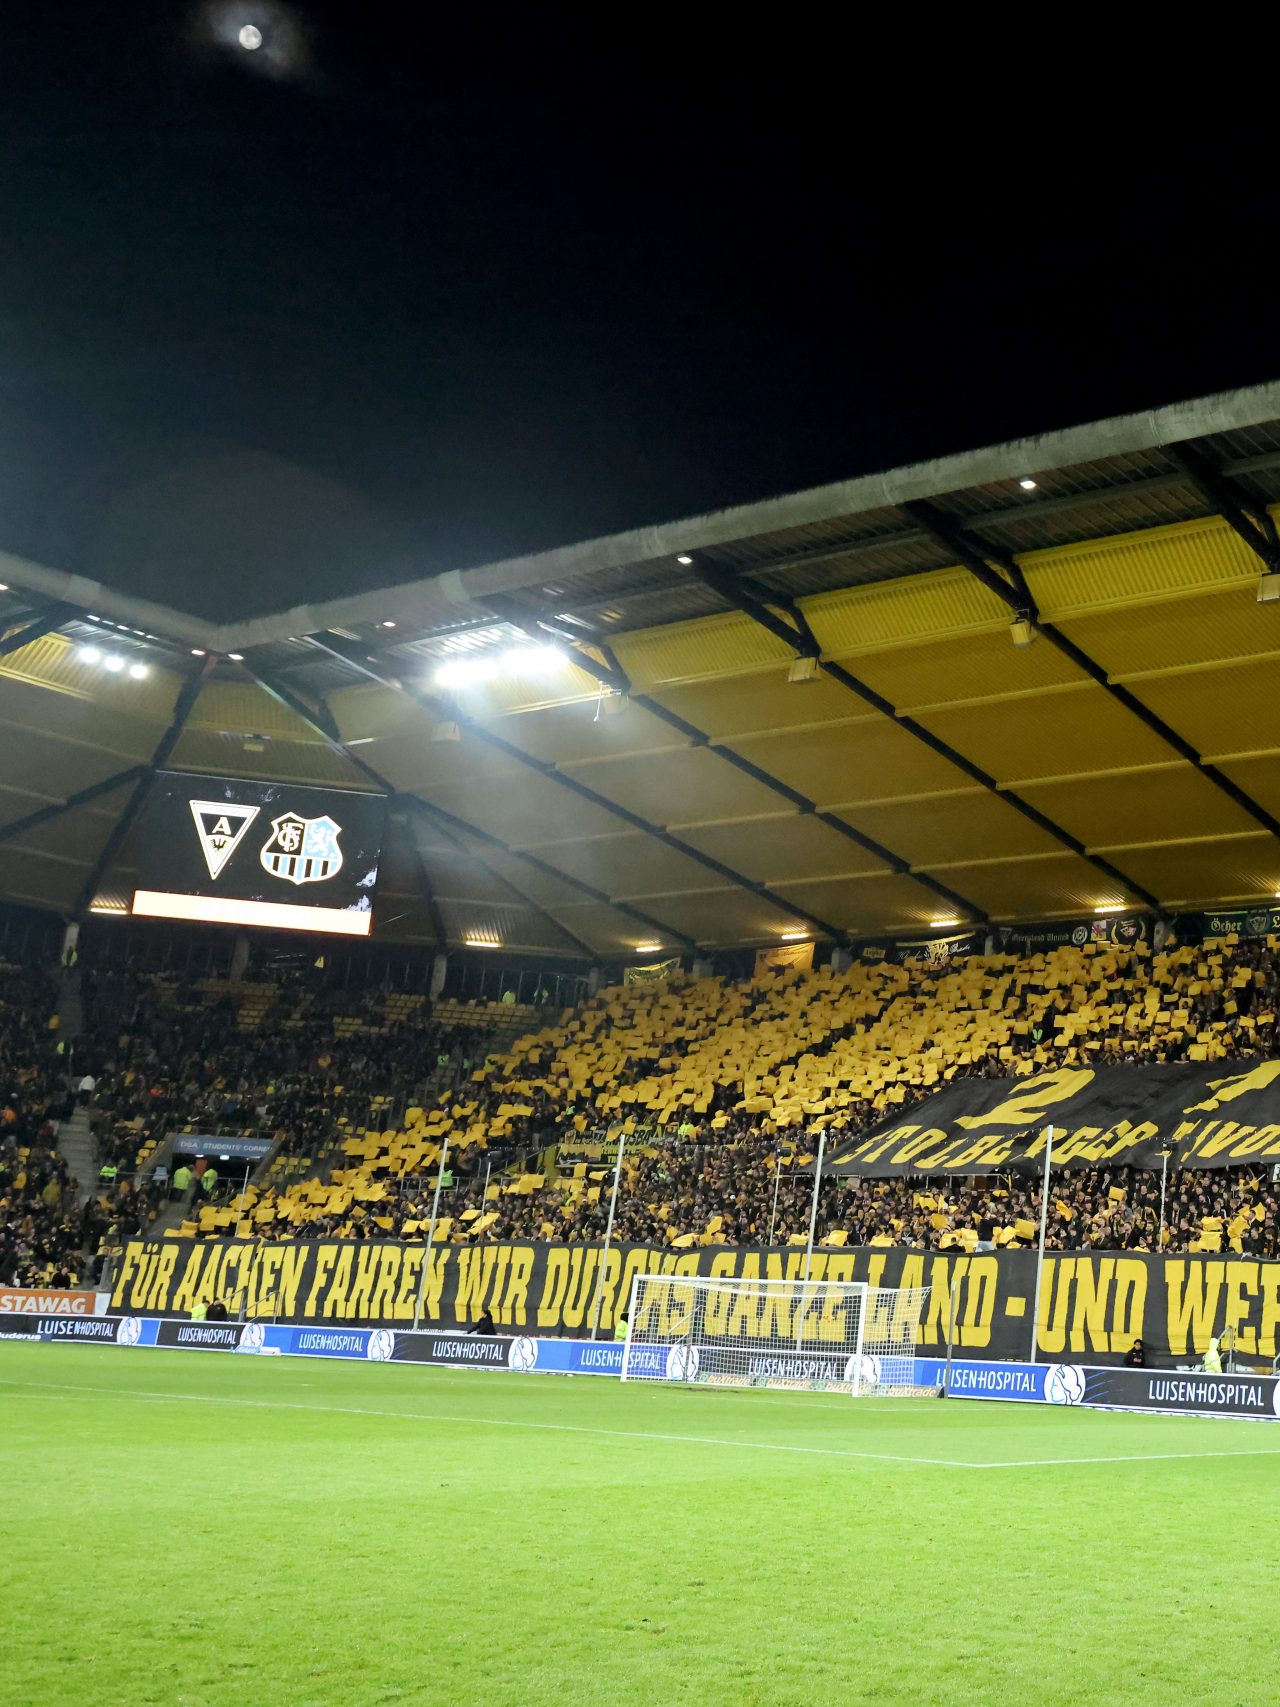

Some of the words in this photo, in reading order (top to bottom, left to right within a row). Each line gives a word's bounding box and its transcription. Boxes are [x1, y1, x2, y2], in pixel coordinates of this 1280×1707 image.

[954, 1068, 1096, 1129] 2
[0, 1295, 87, 1313] STAWAG
[111, 1242, 180, 1311] FÜR
[172, 1244, 310, 1318] AACHEN
[304, 1245, 452, 1319] FAHREN
[454, 1246, 535, 1326] WIR
[704, 1252, 856, 1343] GANZE
[1036, 1257, 1148, 1354] UND
[0, 1332, 41, 1341] uderus
[580, 1348, 660, 1369] LUISENHSPITAL
